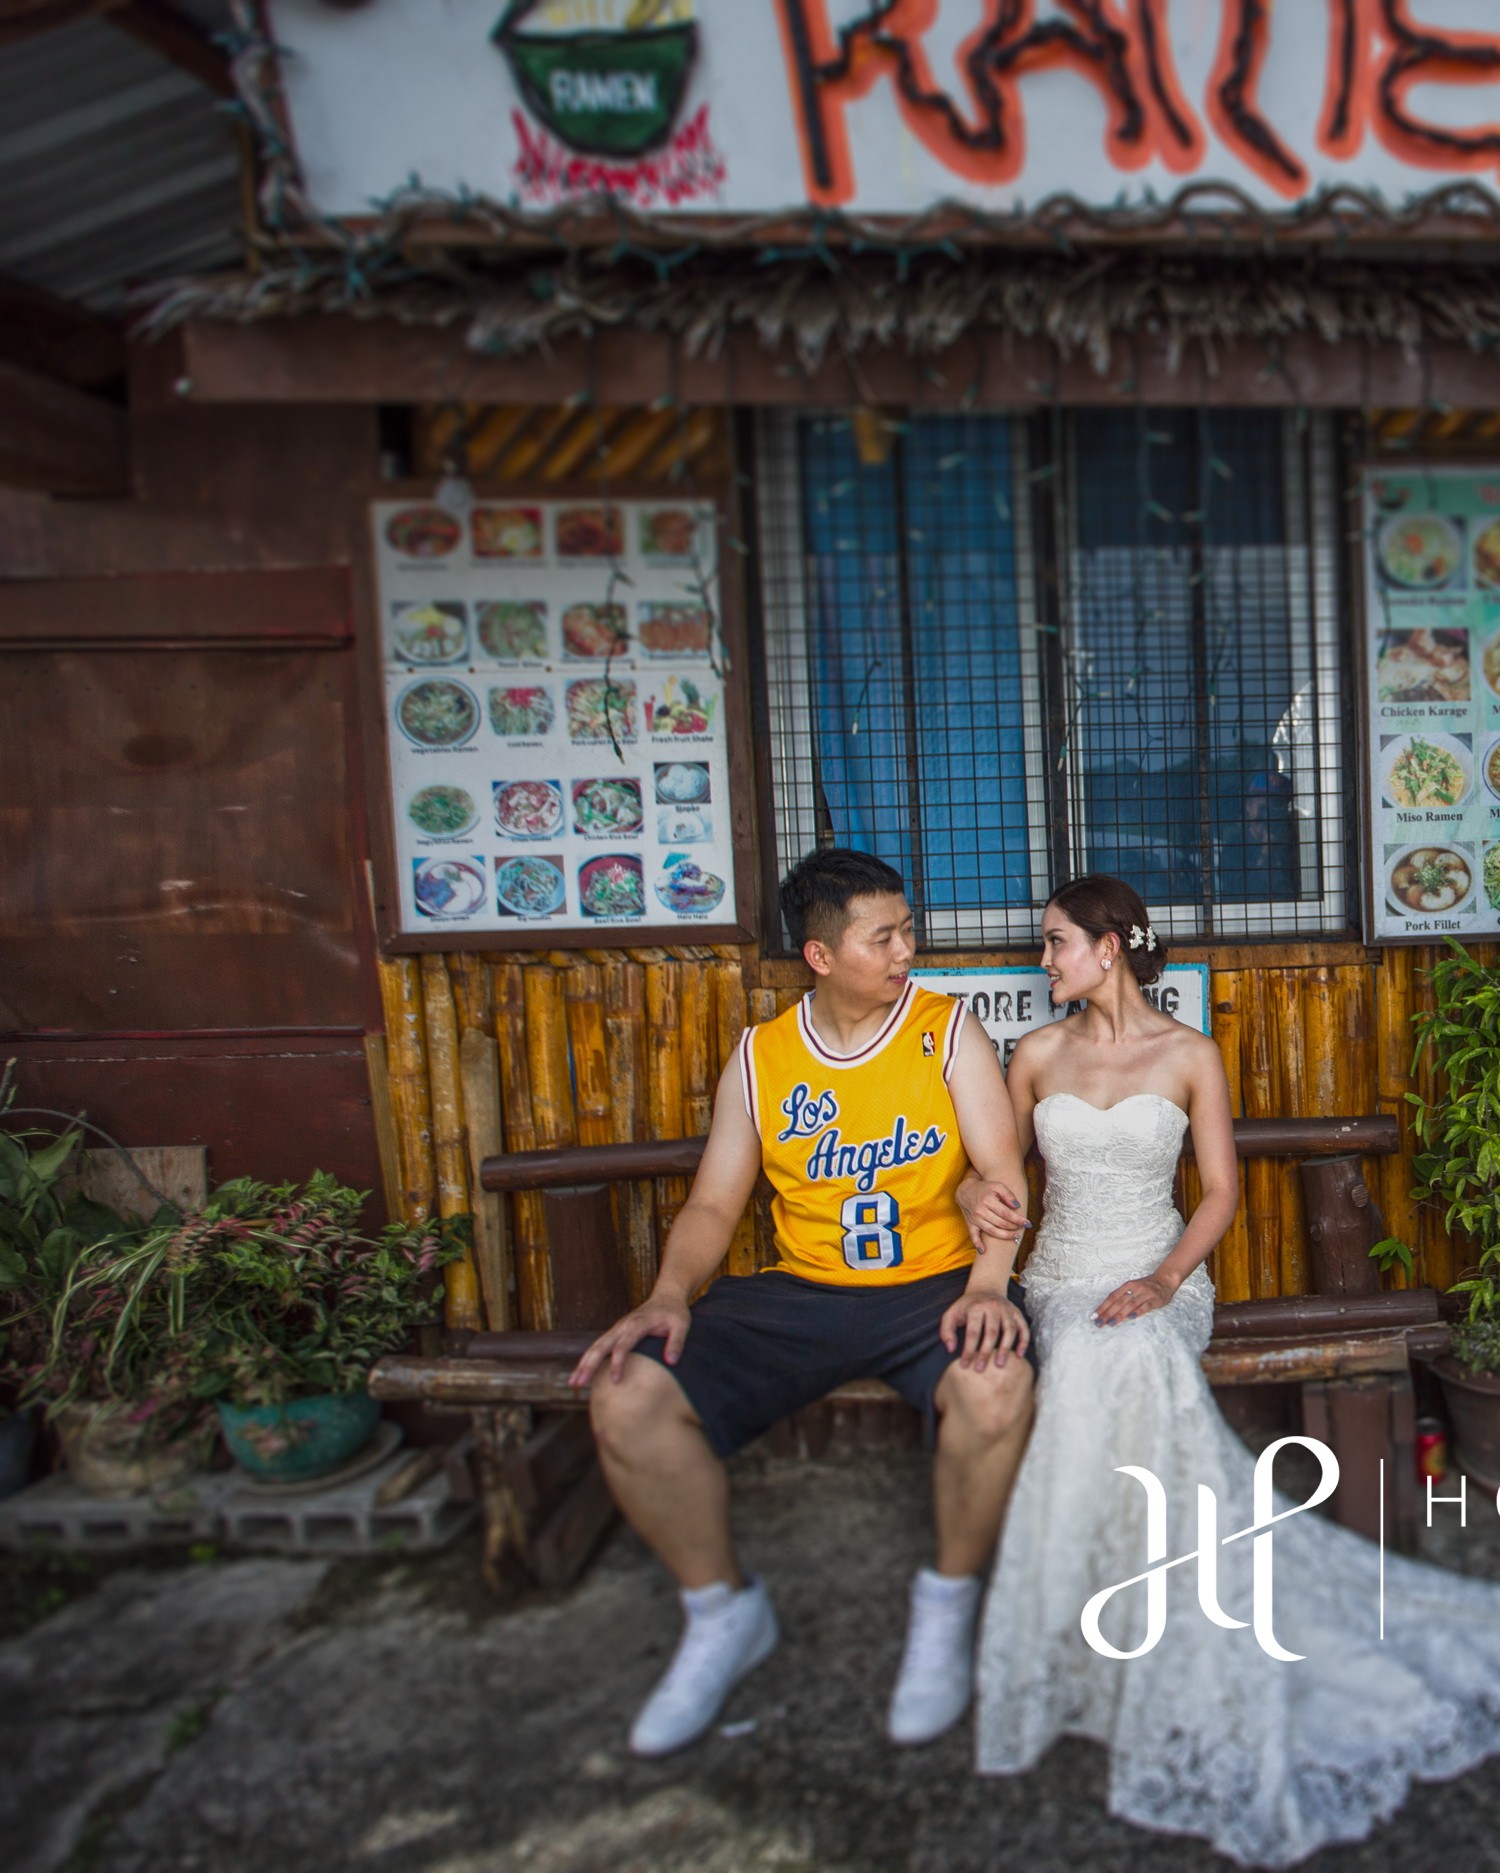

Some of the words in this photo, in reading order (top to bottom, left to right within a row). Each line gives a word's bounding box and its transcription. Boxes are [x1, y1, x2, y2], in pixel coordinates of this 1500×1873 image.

[551, 70, 659, 113] RAMEN
[1381, 706, 1424, 717] Chicken
[1428, 705, 1468, 720] Karage
[1396, 812, 1422, 823] Miso
[1426, 811, 1463, 822] Ramen
[1405, 921, 1430, 931] Pork
[1434, 920, 1460, 930] Fillet
[779, 1082, 839, 1142] Los
[807, 1116, 945, 1191] Angeles
[840, 1192, 903, 1270] 8
